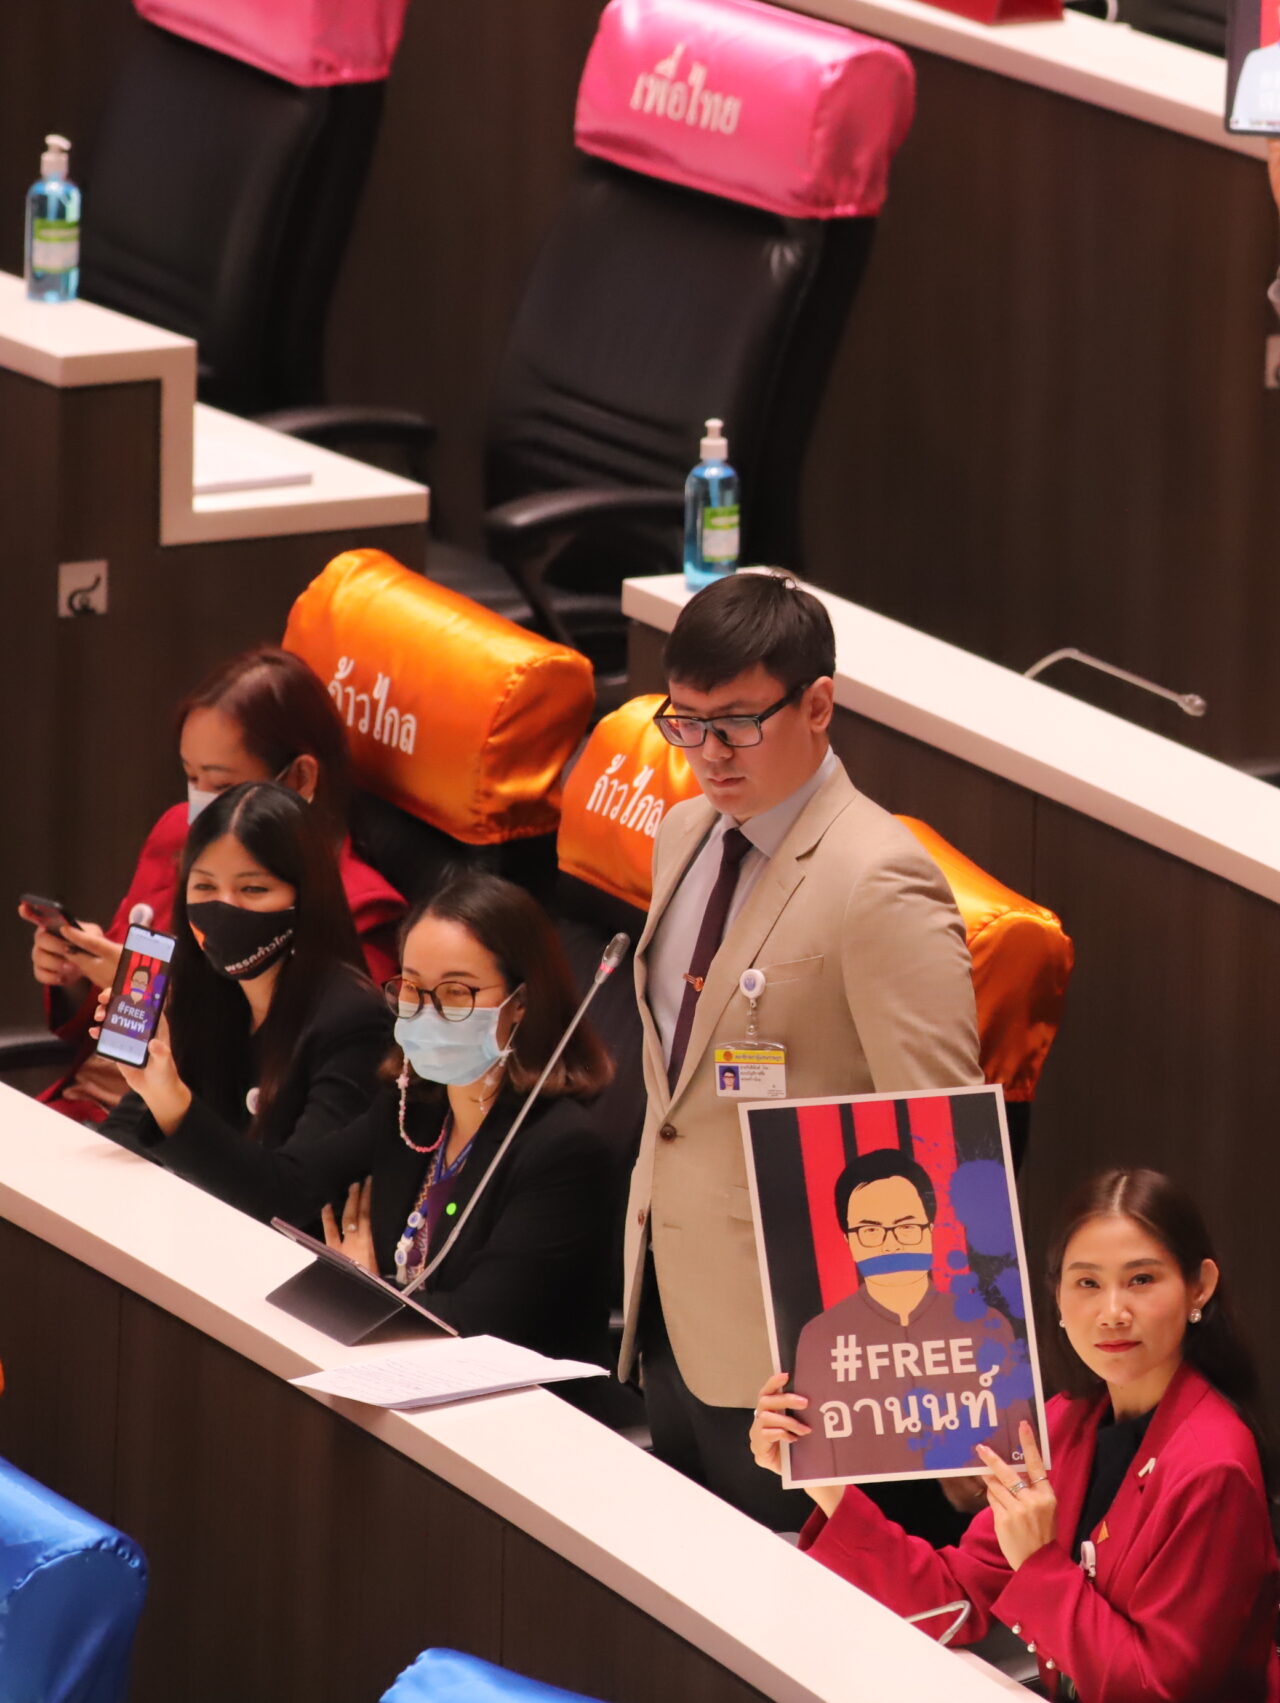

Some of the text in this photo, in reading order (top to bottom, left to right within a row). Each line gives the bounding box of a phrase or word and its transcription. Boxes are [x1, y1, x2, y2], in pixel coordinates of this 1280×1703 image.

[629, 43, 742, 135] เพื่อไทย
[328, 655, 417, 755] ก้าวไกล
[586, 753, 665, 839] ก้าวไกล
[111, 1013, 148, 1033] อานนท์
[117, 1001, 146, 1019] #FREE
[831, 1334, 977, 1382] #FREE
[819, 1364, 1000, 1439] อานนท์
